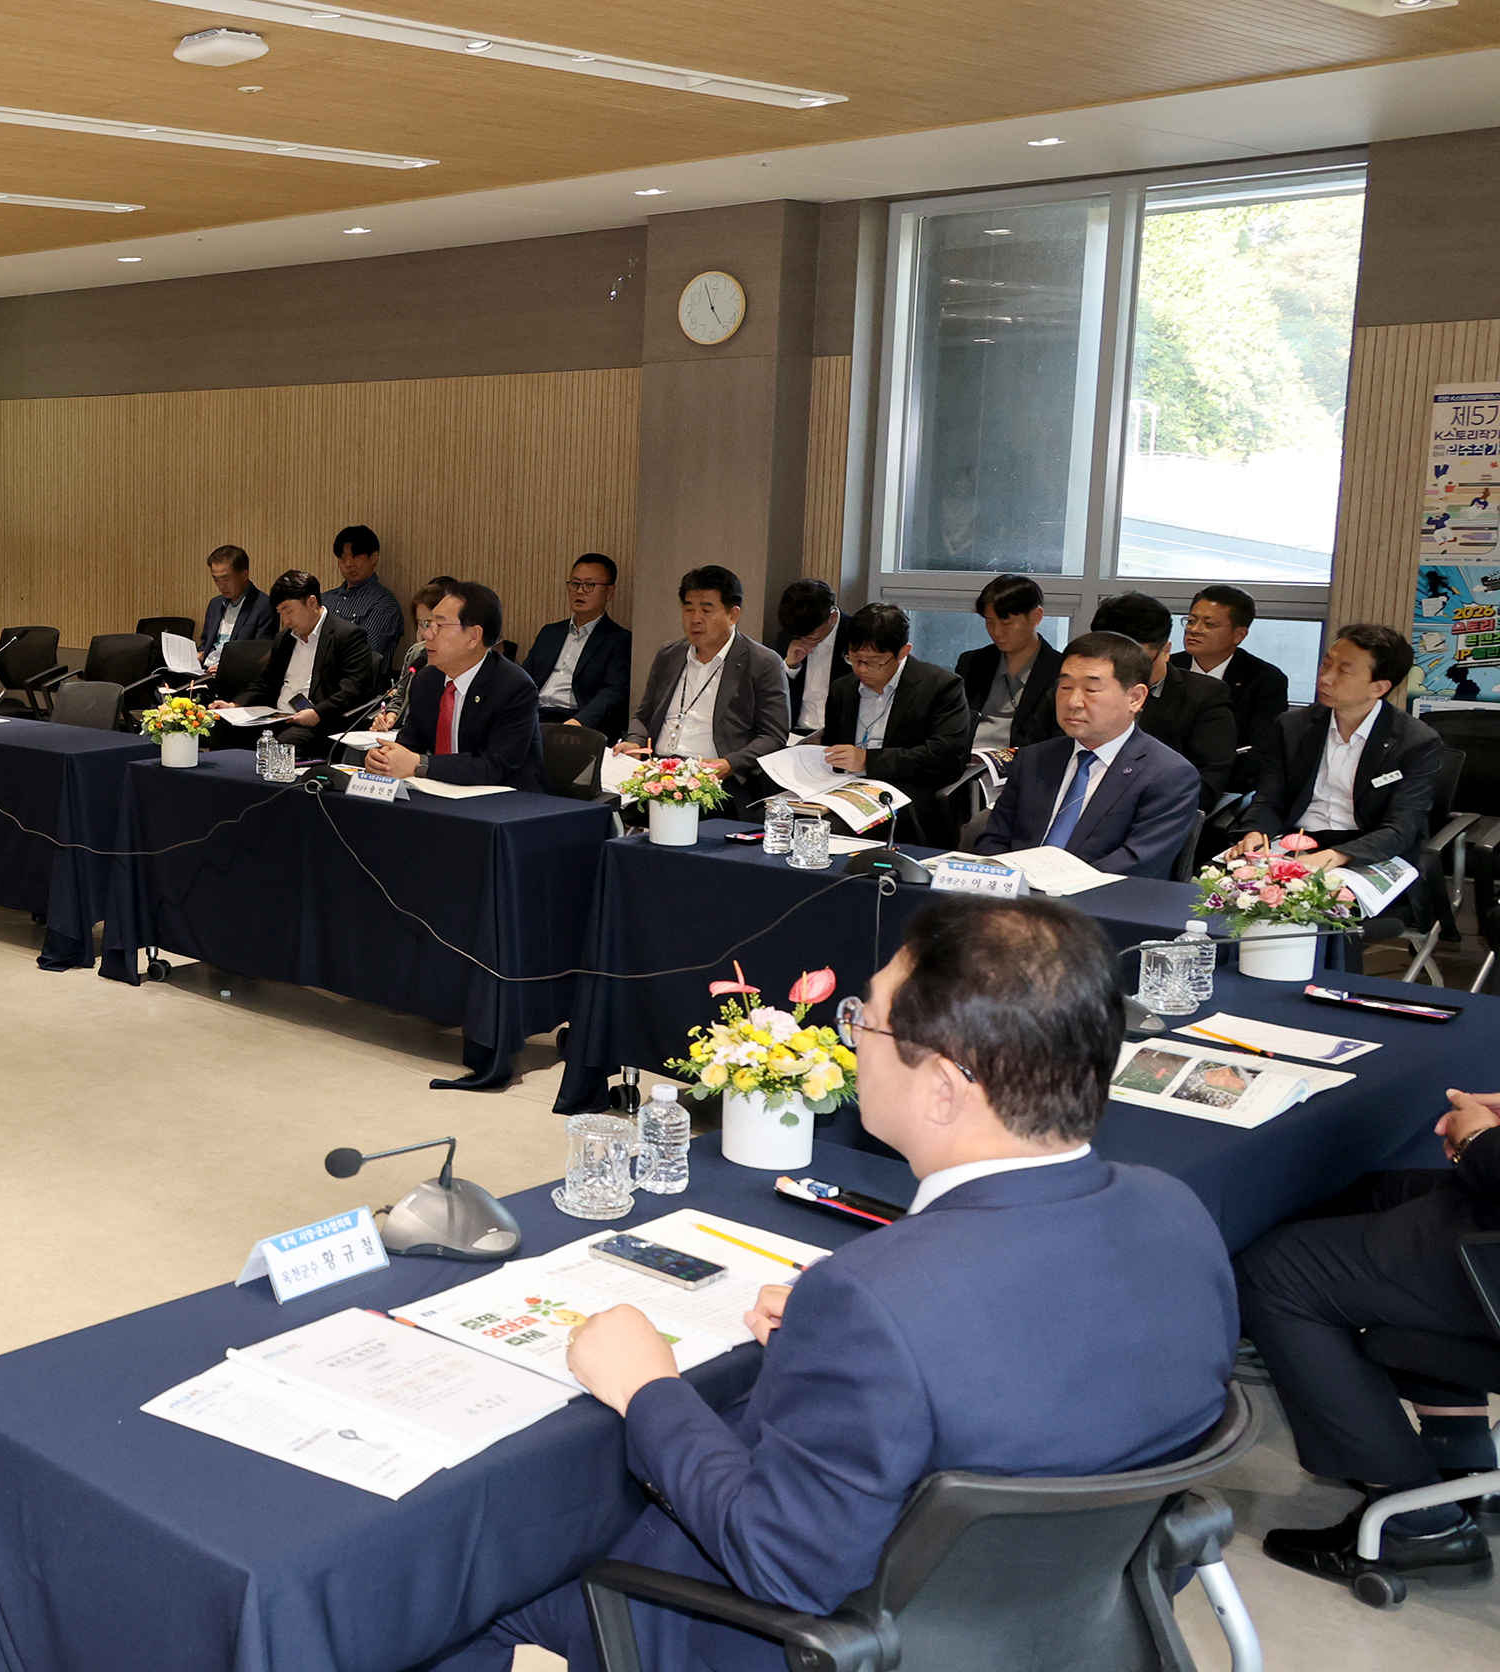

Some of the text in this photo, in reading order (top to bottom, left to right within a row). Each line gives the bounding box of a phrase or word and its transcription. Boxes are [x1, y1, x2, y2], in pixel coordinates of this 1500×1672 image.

[1452, 604, 1496, 620] 2026
[1451, 618, 1496, 635] 스토리
[972, 879, 1013, 893] 이재영
[280, 1234, 298, 1250] 충북
[282, 1235, 376, 1285] 옥천군수 황규철
